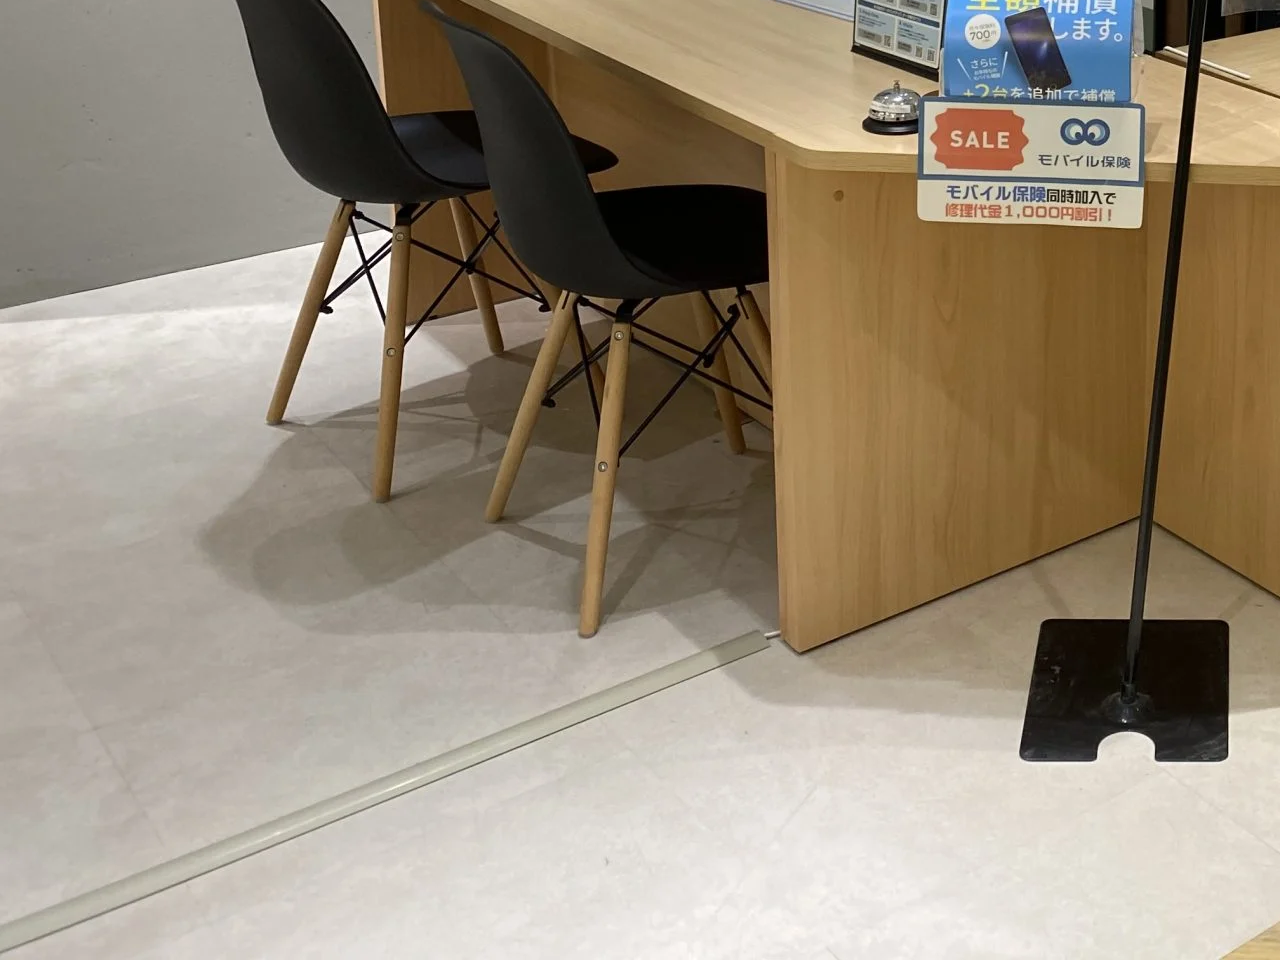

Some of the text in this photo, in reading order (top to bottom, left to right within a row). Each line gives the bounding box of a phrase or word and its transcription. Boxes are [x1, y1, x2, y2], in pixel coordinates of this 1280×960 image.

[970, 57, 998, 69] さらに
[950, 130, 1010, 149] SALE
[1038, 154, 1131, 169] モバイル保険
[946, 186, 1117, 205] モバイル保険同時加入で
